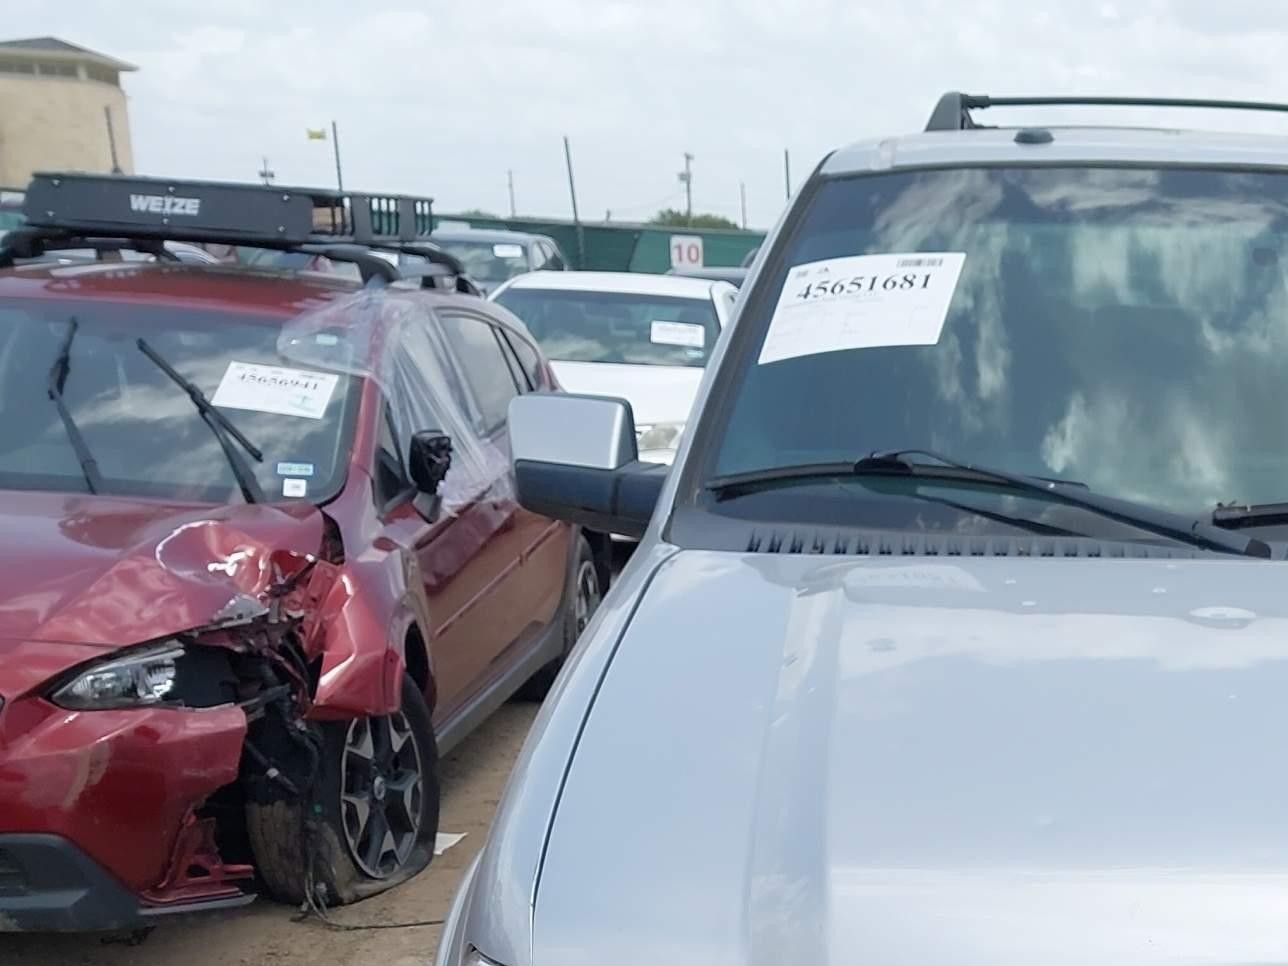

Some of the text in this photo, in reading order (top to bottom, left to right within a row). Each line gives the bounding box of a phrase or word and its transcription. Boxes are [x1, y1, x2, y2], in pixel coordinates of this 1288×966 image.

[129, 194, 200, 215] WEIZE
[673, 244, 700, 262] 10
[796, 273, 931, 300] 45651681
